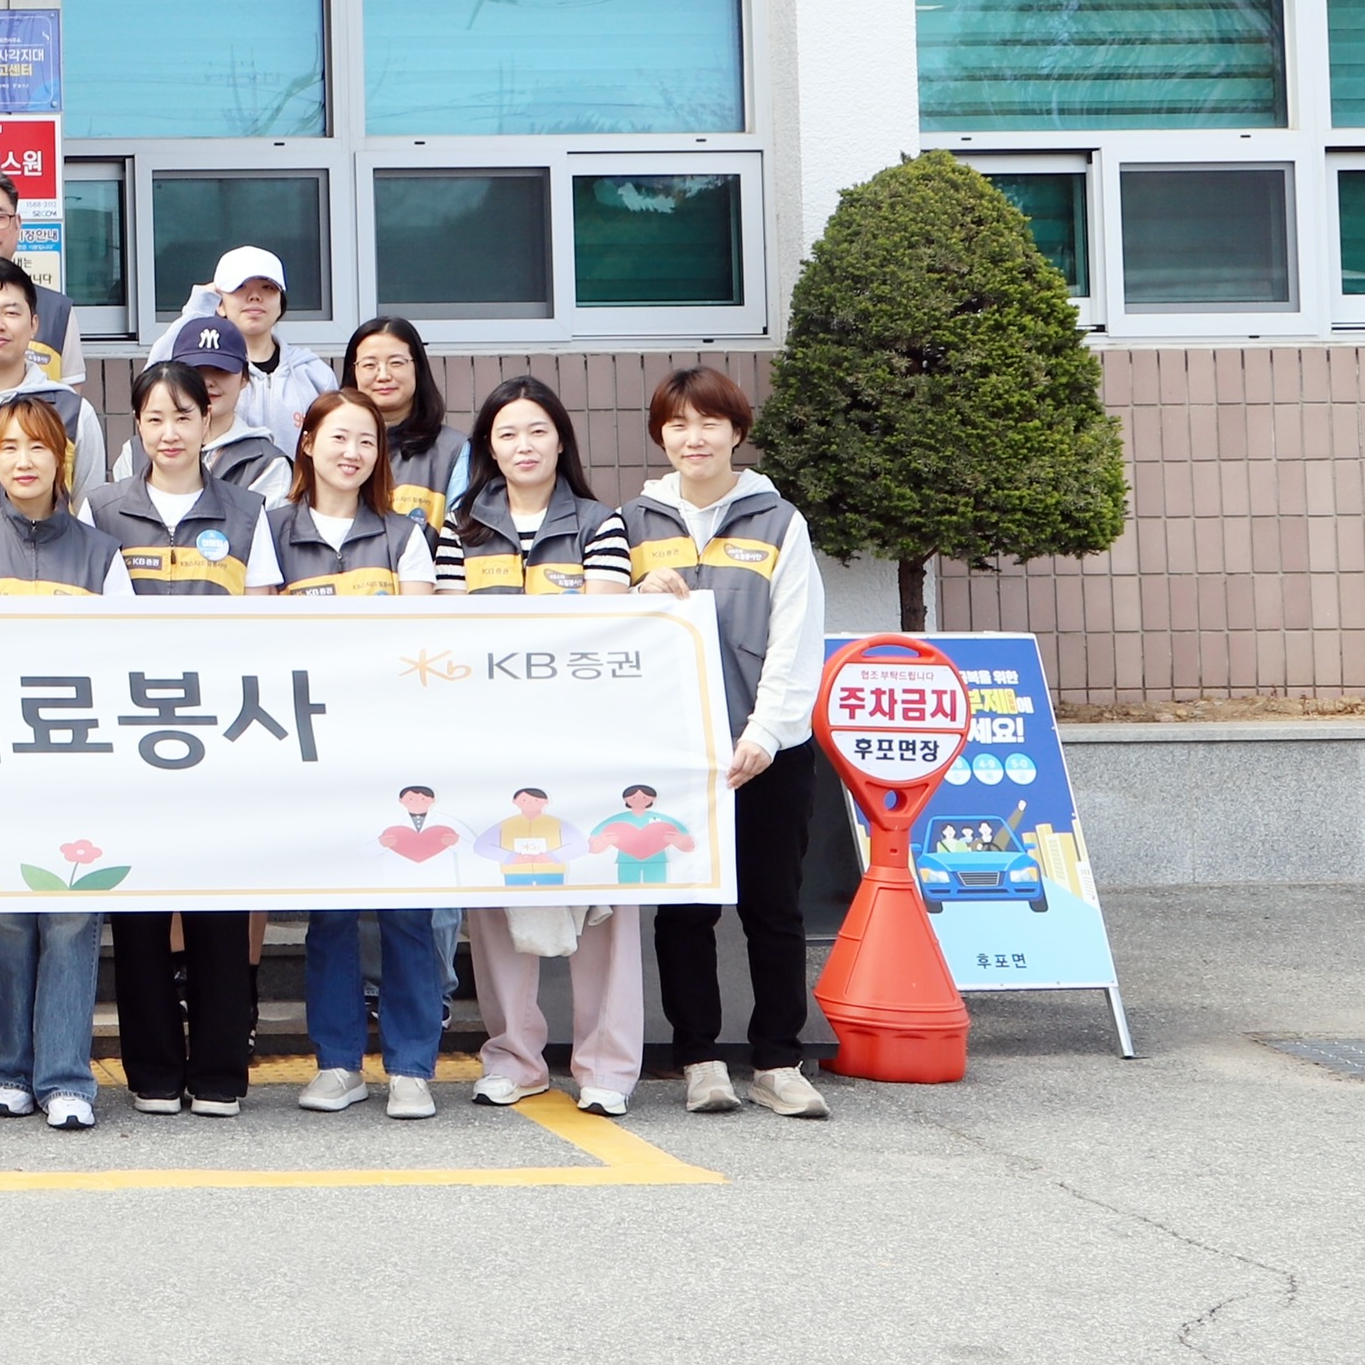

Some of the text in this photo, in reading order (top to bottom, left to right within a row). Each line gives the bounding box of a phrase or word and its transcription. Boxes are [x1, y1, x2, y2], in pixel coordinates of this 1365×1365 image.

[29, 273, 53, 285] 니다
[293, 411, 305, 428] 9
[132, 557, 160, 567] KB증권
[305, 587, 333, 595] KB증권
[487, 649, 643, 681] KB증권
[881, 670, 935, 682] 부탁드립니다
[993, 670, 1019, 685] 위한
[839, 686, 957, 722] 주차금지
[854, 738, 940, 763] 후포면장
[976, 953, 1027, 969] 후포면
